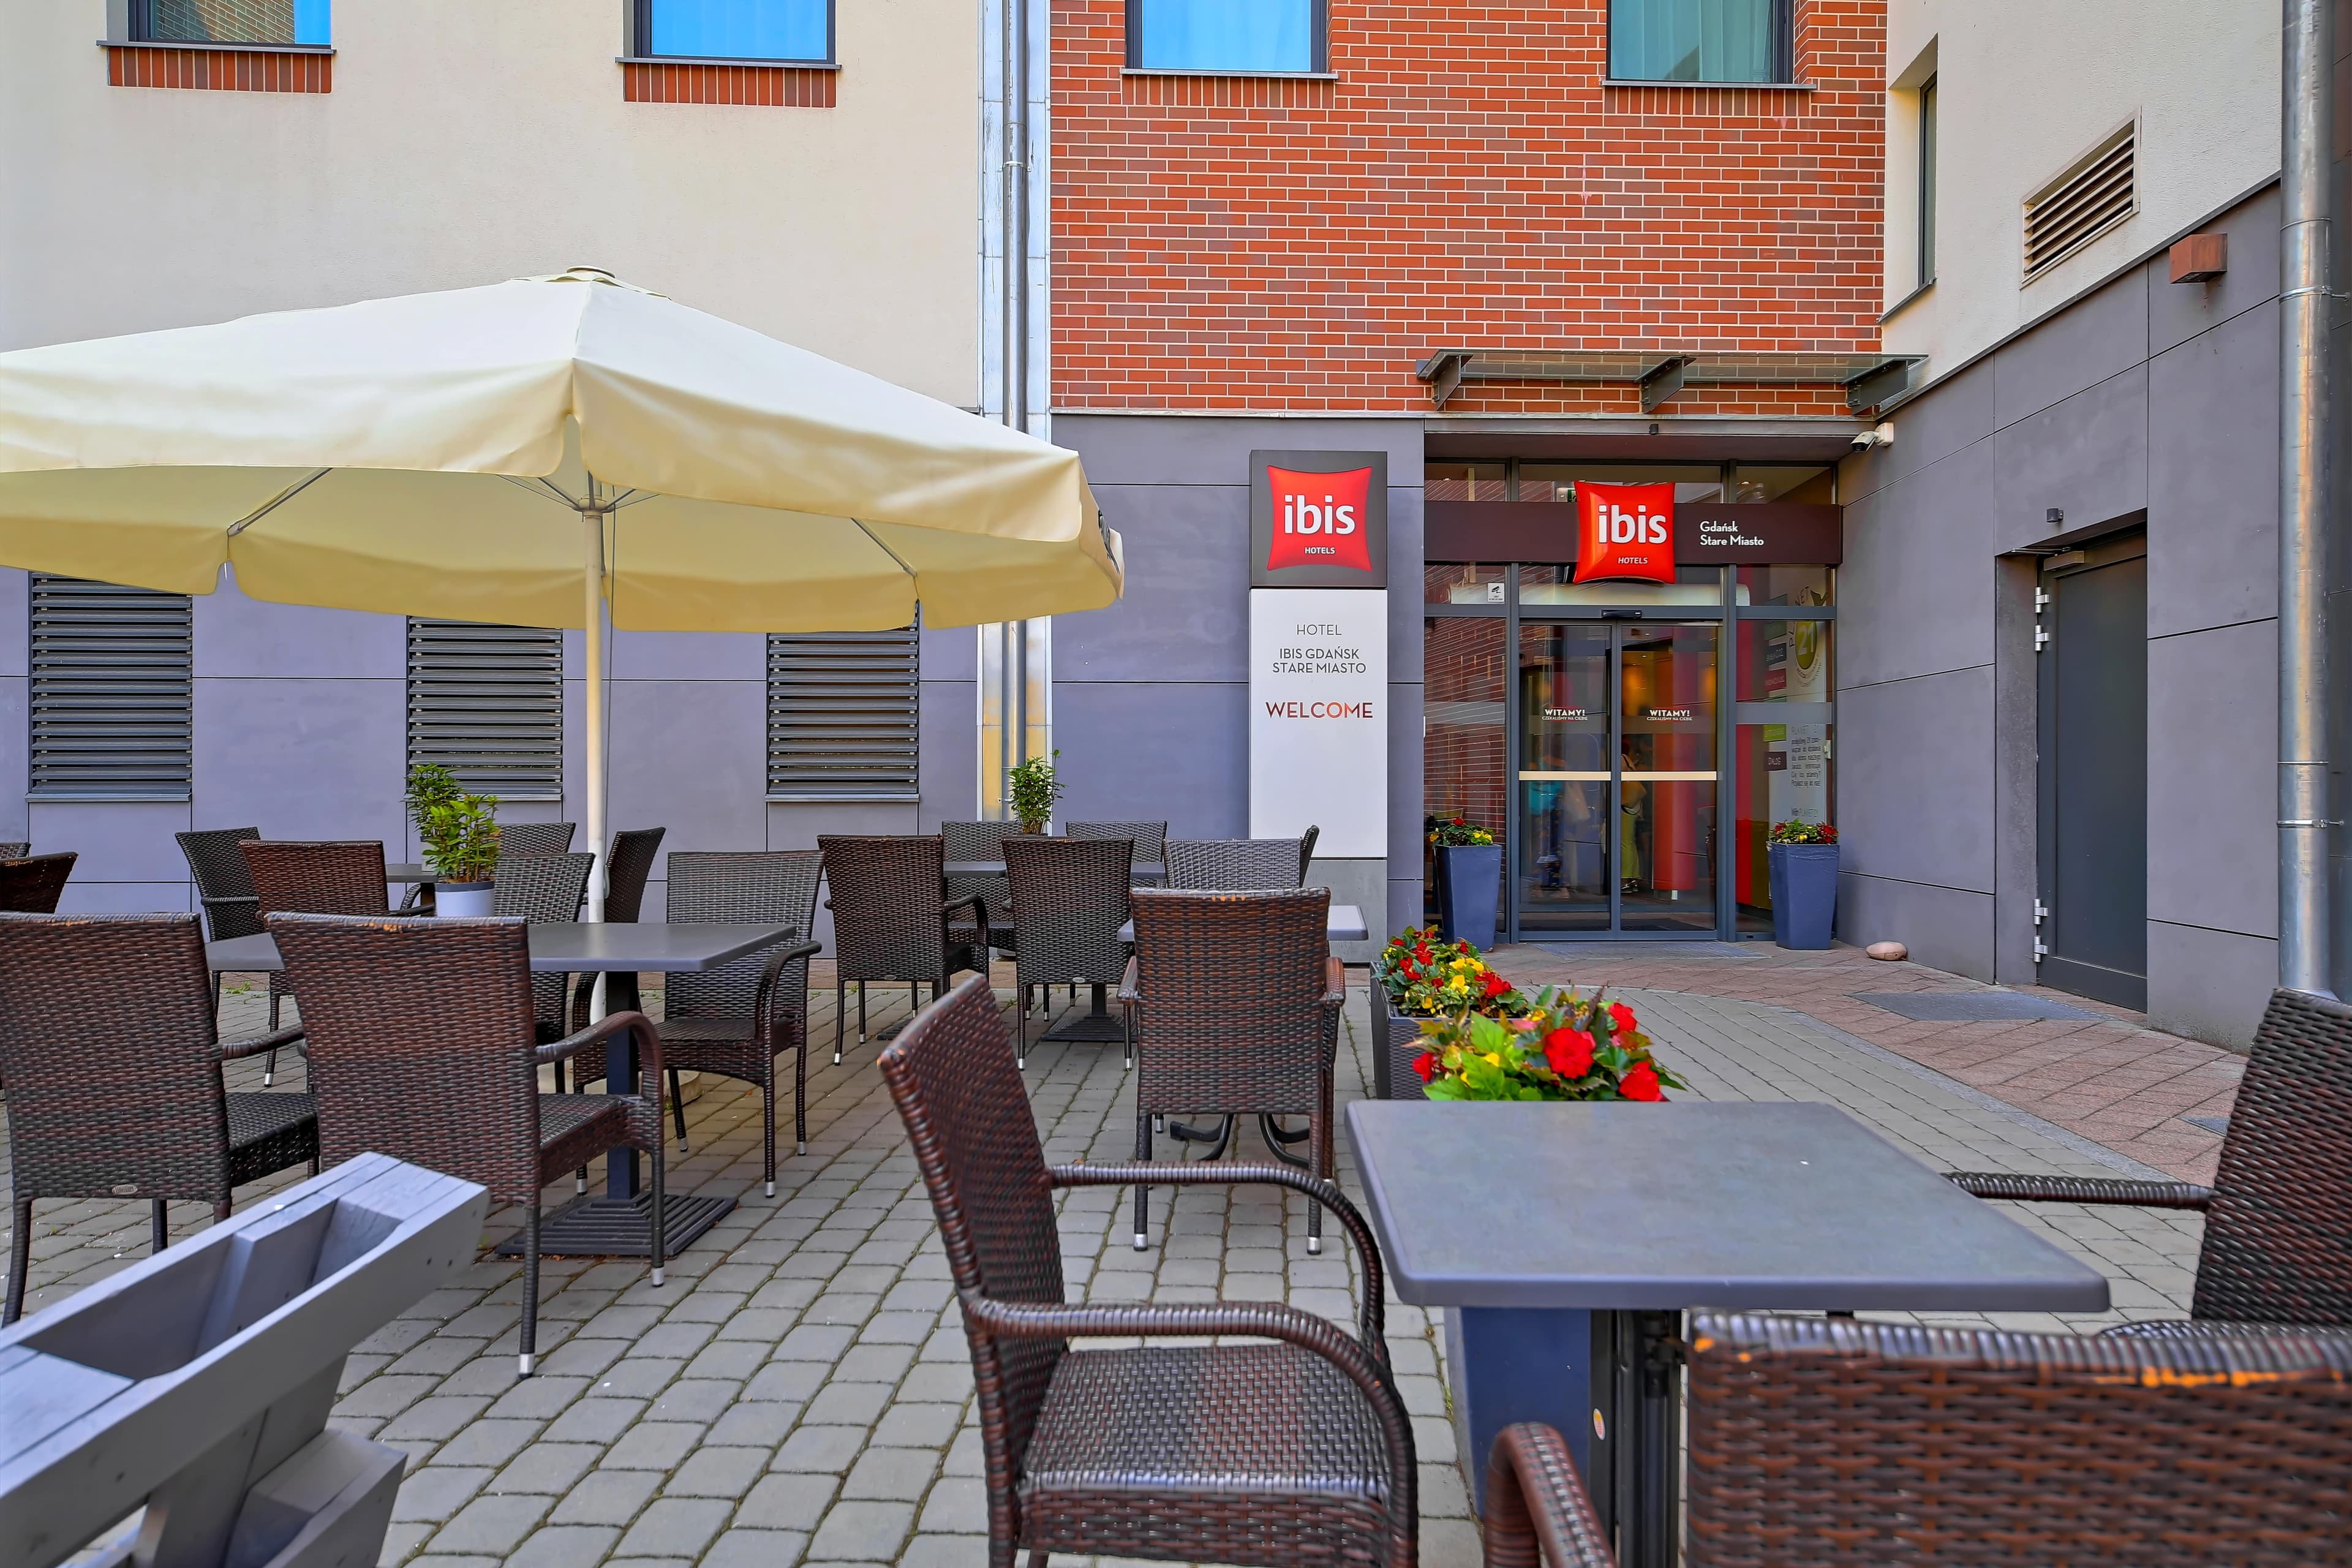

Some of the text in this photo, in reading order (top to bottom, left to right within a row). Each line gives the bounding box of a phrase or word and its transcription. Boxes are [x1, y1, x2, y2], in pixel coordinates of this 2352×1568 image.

[1284, 494, 1355, 535] ibis
[1598, 504, 1667, 544] ibis
[1700, 521, 1738, 532] Gdańsk
[1700, 534, 1764, 546] Stare Miasto
[1297, 624, 1343, 635] HOTEL
[1280, 646, 1360, 660] IBIS GDAŃSK
[1272, 662, 1366, 674] STARE MIASTO
[1265, 701, 1373, 718] WELCOME
